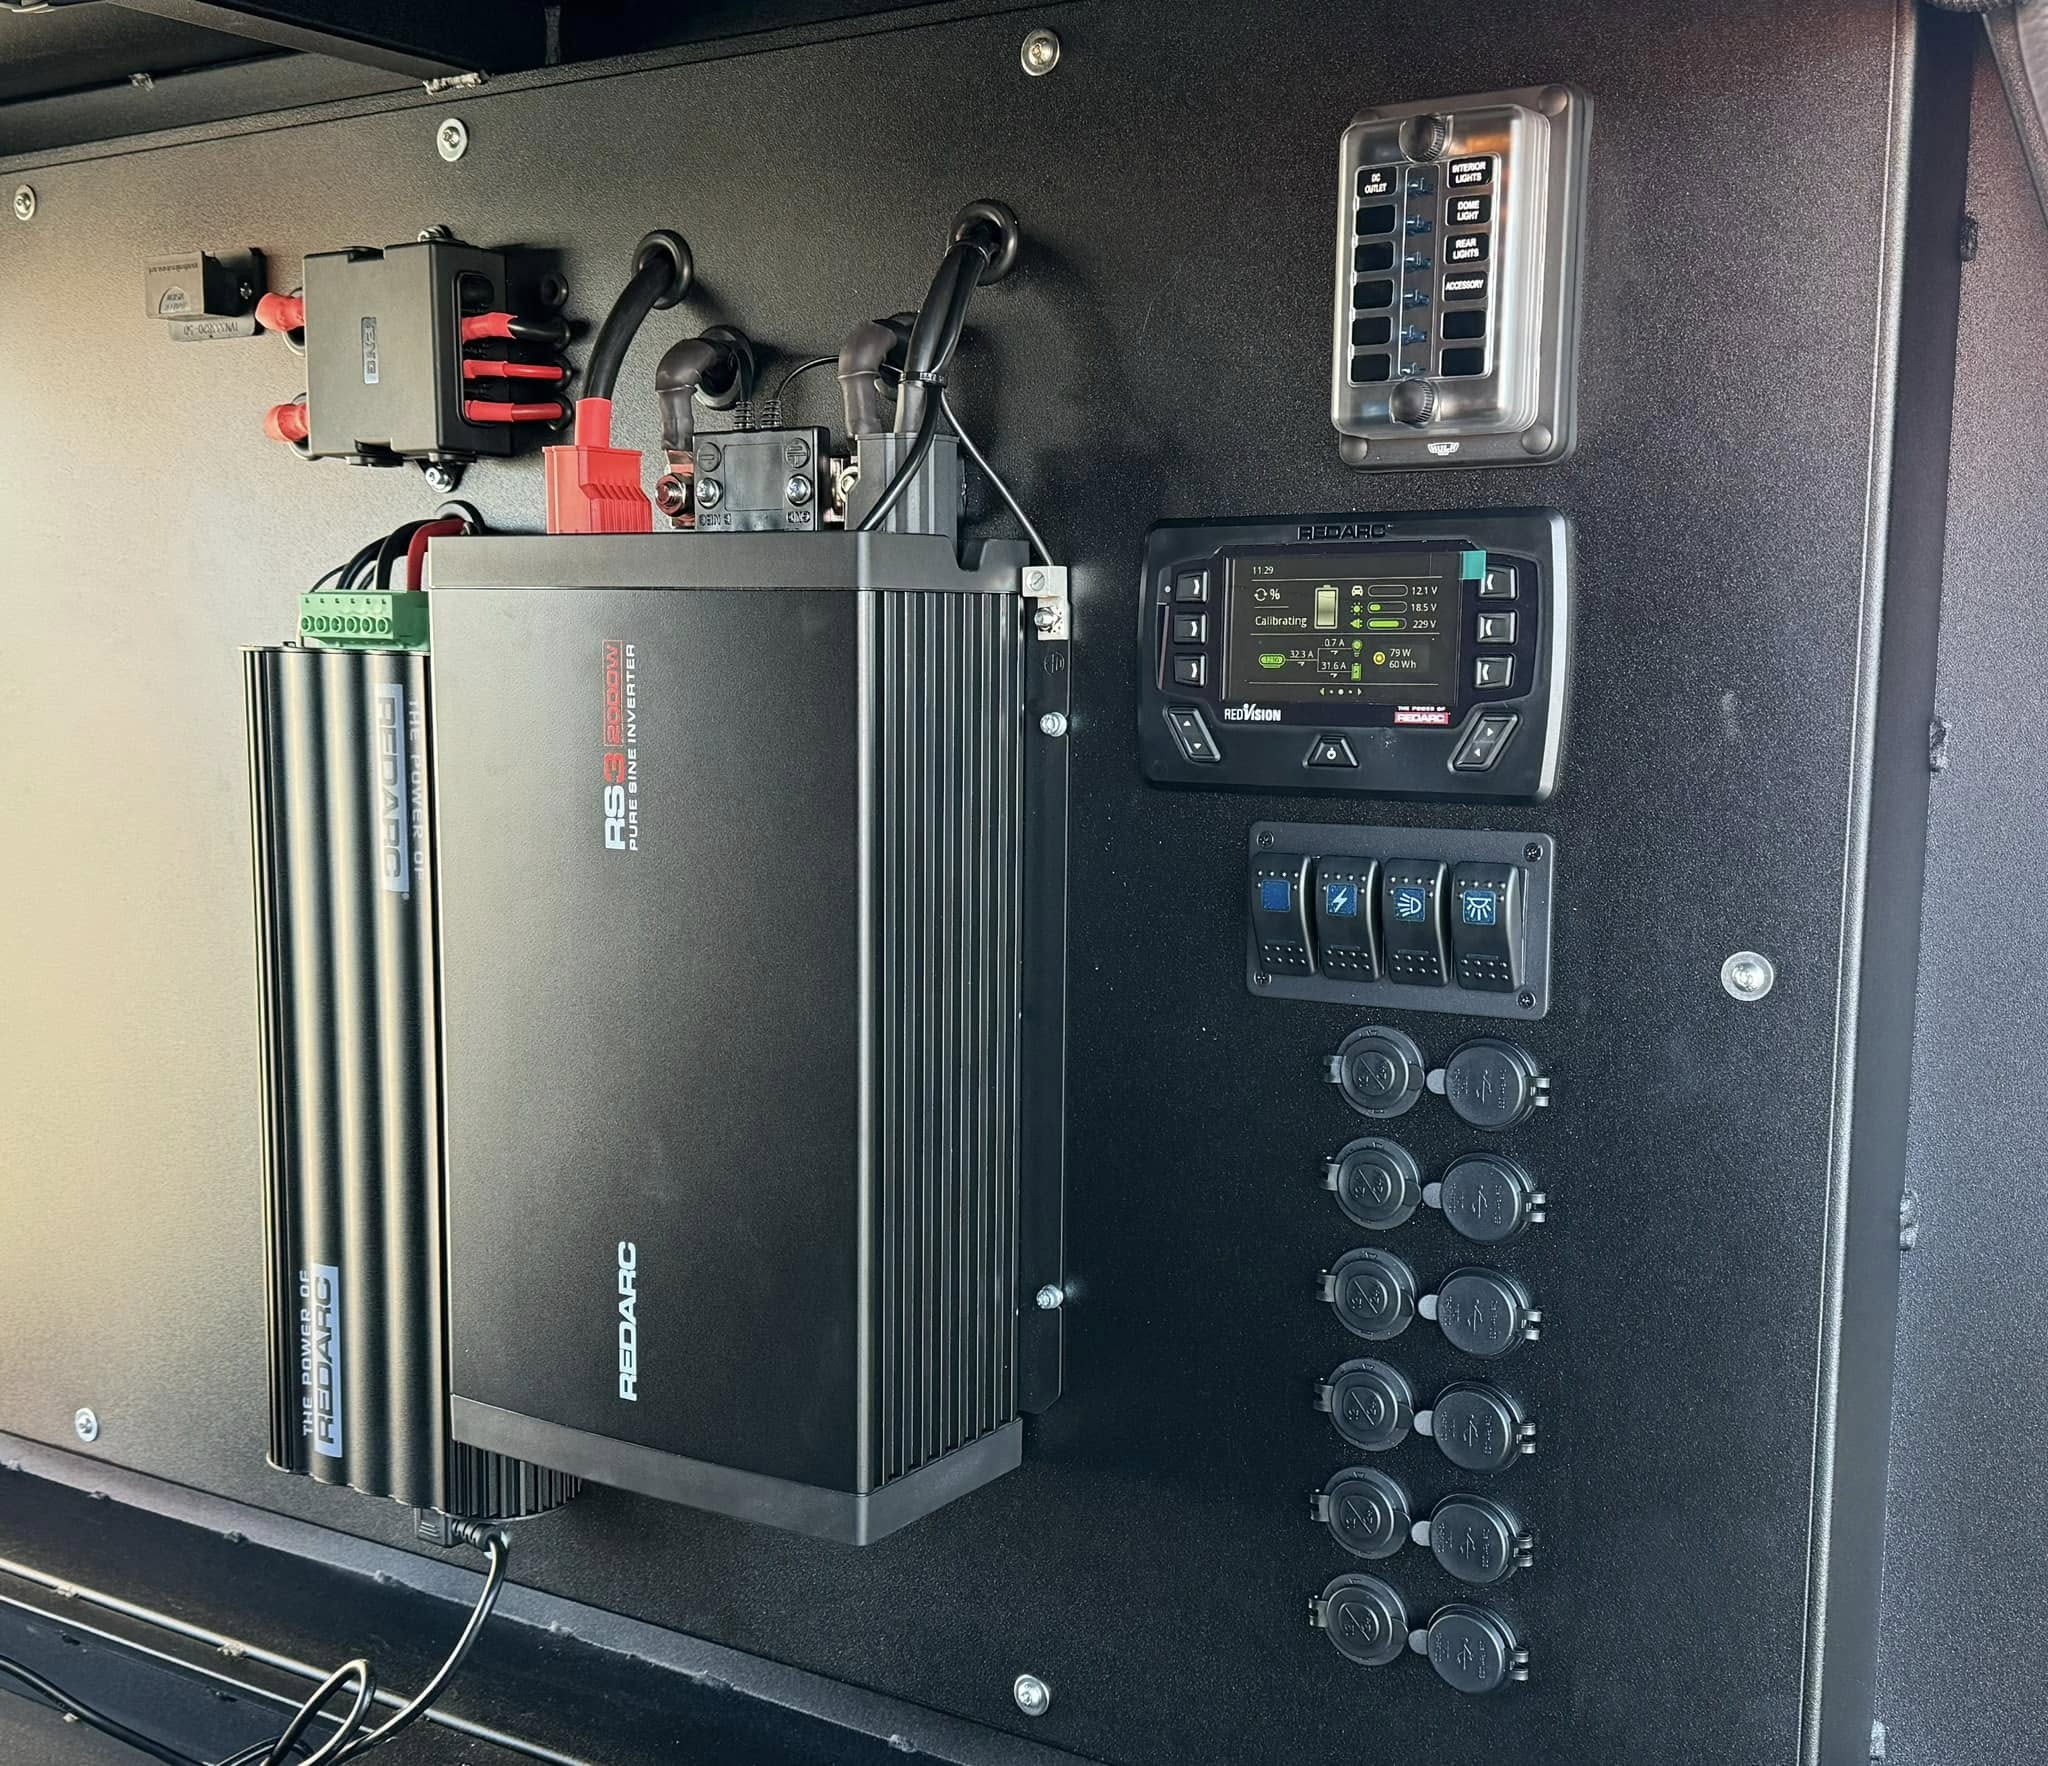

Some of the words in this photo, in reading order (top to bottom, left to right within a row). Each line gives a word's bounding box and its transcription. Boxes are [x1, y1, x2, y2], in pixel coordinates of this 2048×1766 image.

[1452, 161, 1487, 173] INTERIOR
[1371, 173, 1381, 183] DC
[1455, 172, 1482, 184] LIGHTS
[1364, 183, 1388, 194] OUTLET
[1457, 200, 1480, 210] DOME
[1457, 210, 1480, 221] LIGHT
[1455, 238, 1477, 249] REAR
[1452, 248, 1480, 260] LIGHTS
[1445, 279, 1485, 291] ACCESSORY
[1297, 524, 1386, 540] REDARC
[1269, 588, 1281, 600] %
[1411, 586, 1430, 596] 12.1
[1431, 586, 1438, 596] V
[1411, 603, 1429, 612] 18.5
[1430, 603, 1437, 612] V
[1255, 615, 1308, 628] Calibrating
[1412, 620, 1429, 629] 229
[1430, 620, 1437, 629] V
[1324, 639, 1337, 647] 0.7
[1338, 639, 1345, 647] A
[1290, 650, 1306, 659] 32.3
[1306, 650, 1314, 659] A
[1390, 649, 1401, 658] 79
[1401, 649, 1412, 658] W
[1321, 662, 1339, 671] 31.6
[1339, 662, 1347, 671] A
[1389, 660, 1400, 669] 60
[1401, 660, 1417, 669] Wh
[606, 645, 620, 745] 2000W
[626, 644, 637, 743] INVERTER
[408, 701, 421, 741] THE
[1397, 712, 1444, 724] REDARC
[628, 748, 637, 794] SINE
[379, 697, 401, 878] REDARC
[410, 754, 423, 840] POWER
[604, 752, 625, 851] RS3
[629, 799, 639, 851] PURE
[412, 850, 425, 881] OF
[299, 1269, 310, 1297] OF
[618, 1241, 638, 1402] REDARC
[300, 1308, 313, 1386] POWER
[315, 1276, 335, 1444] REDARC
[302, 1396, 313, 1437] THE
